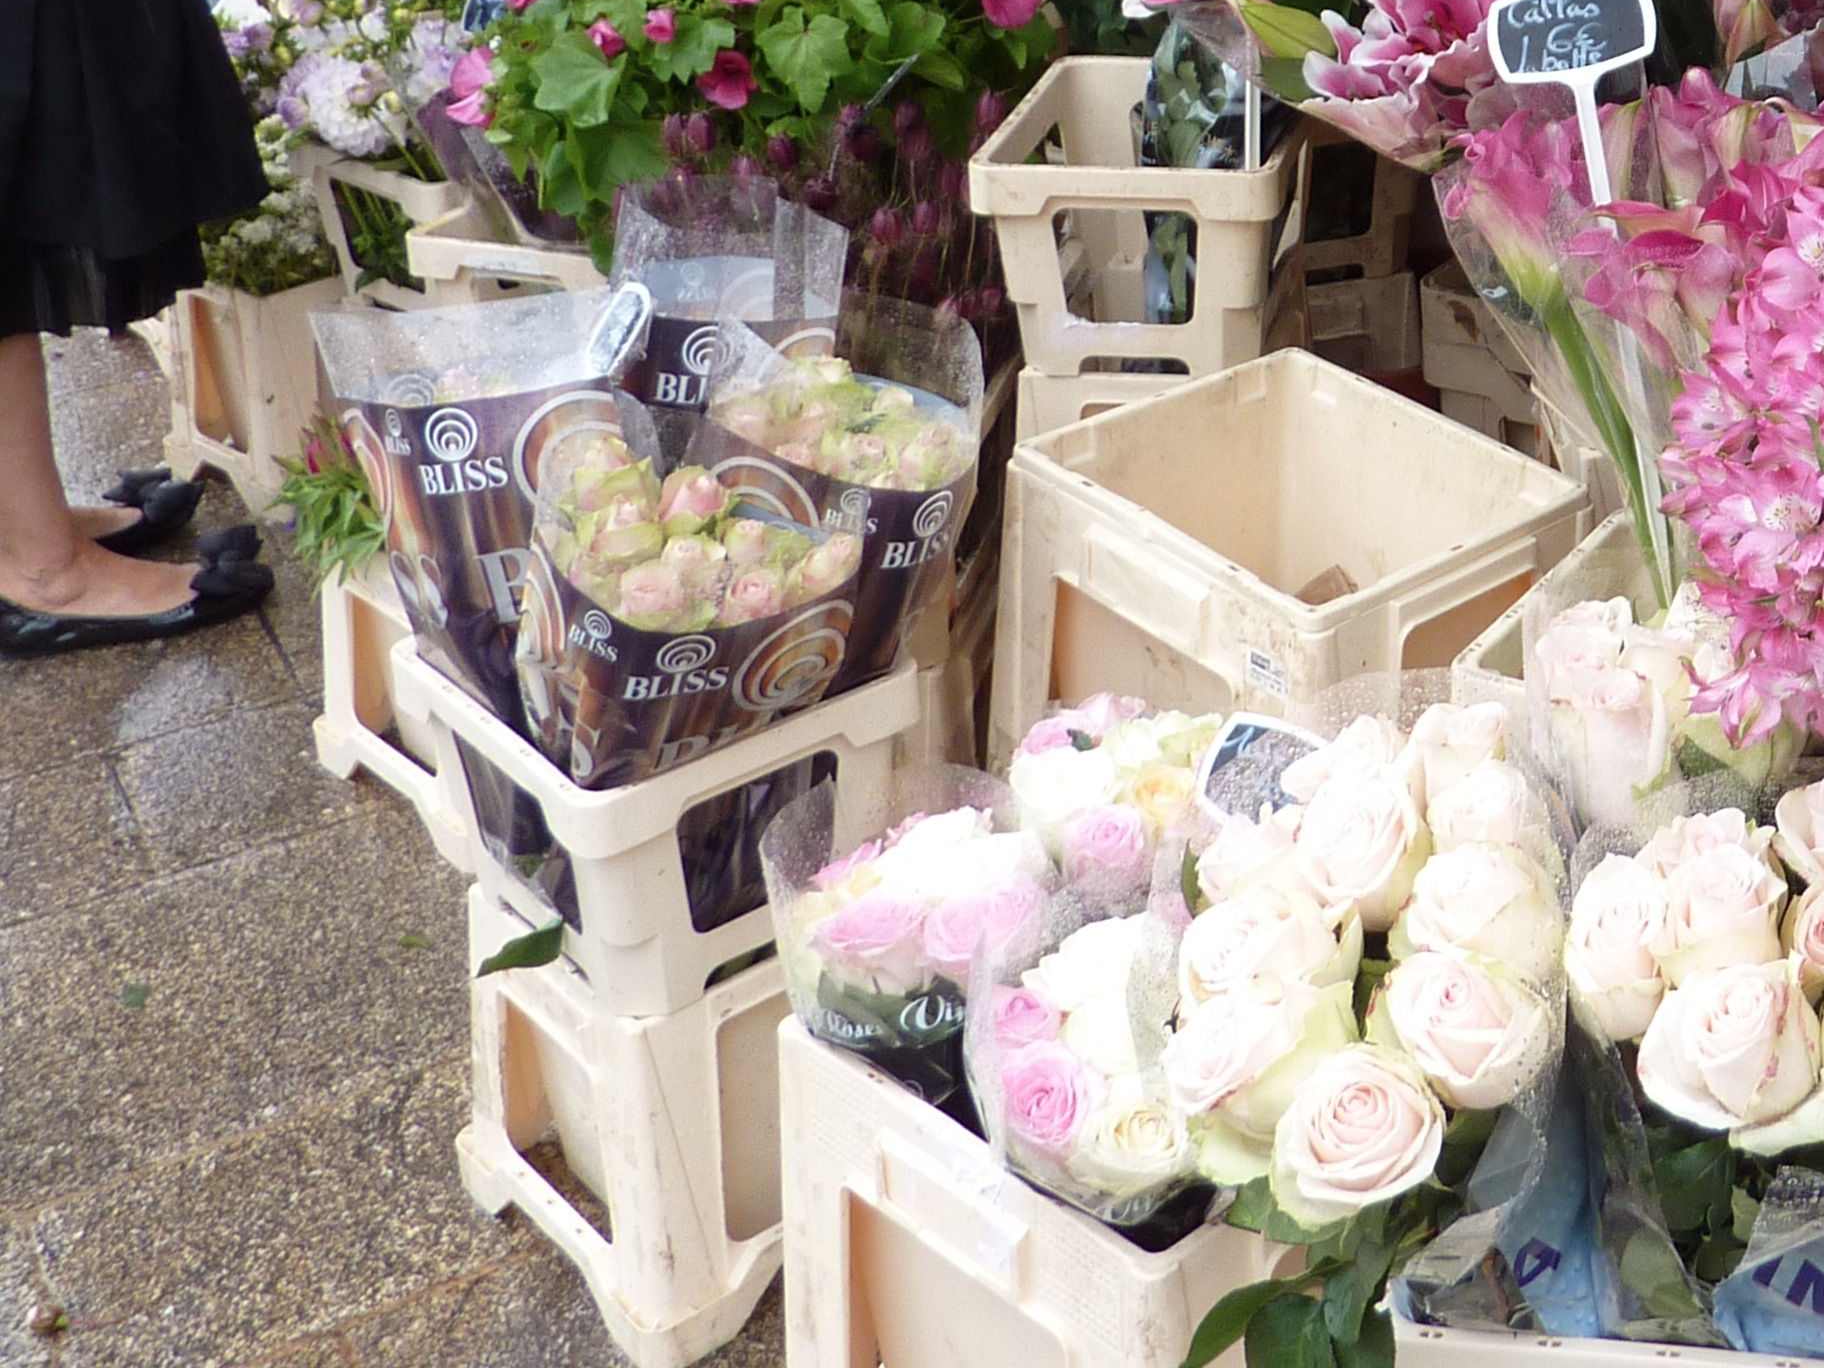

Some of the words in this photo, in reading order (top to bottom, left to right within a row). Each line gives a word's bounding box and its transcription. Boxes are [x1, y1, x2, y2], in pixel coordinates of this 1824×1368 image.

[418, 456, 509, 496] BLISS
[568, 624, 618, 663] BLISS
[621, 666, 730, 702] BLISS
